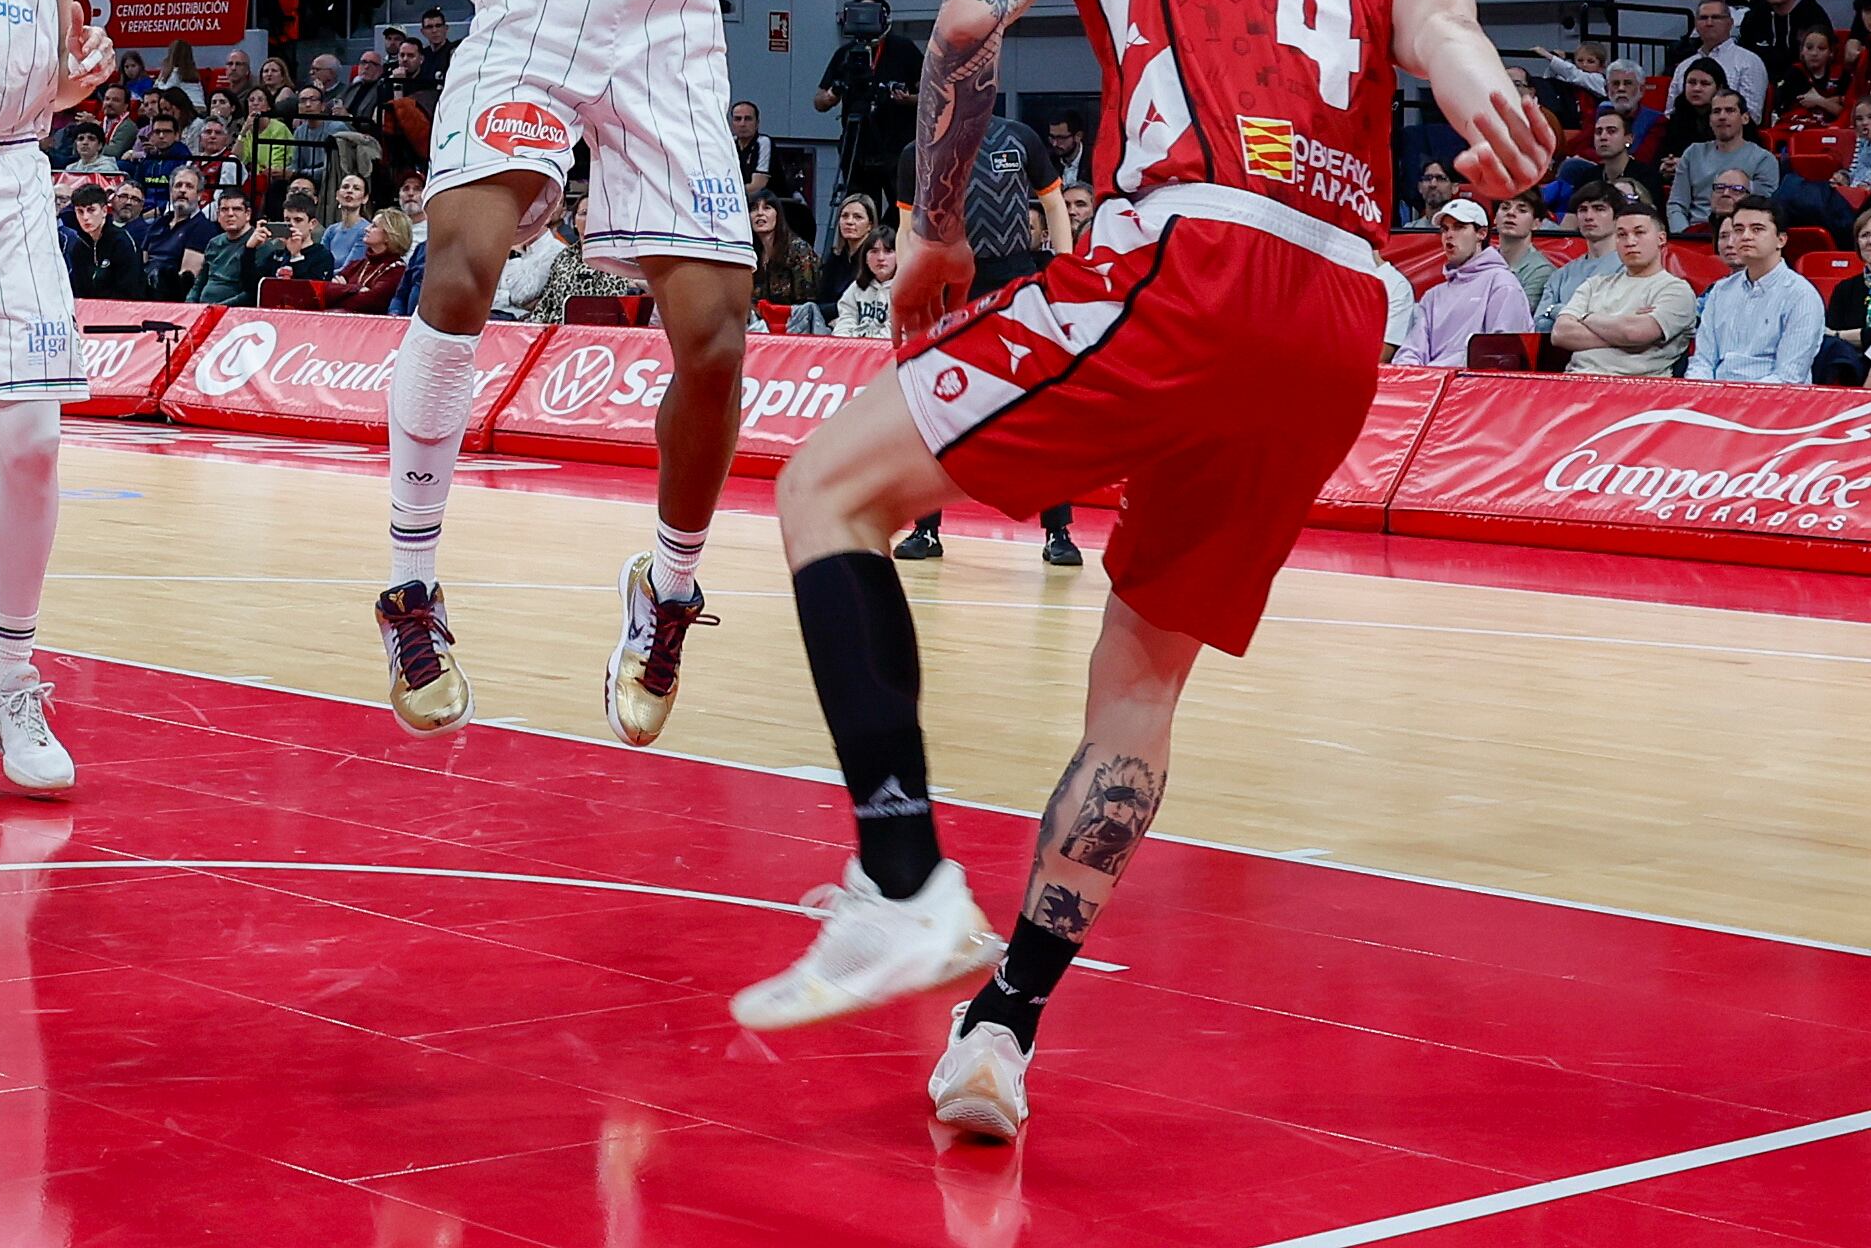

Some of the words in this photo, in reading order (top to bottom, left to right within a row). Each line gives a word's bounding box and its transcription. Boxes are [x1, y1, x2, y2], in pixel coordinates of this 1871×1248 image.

[116, 3, 152, 18] CENTRO
[153, 2, 166, 16] DE
[120, 20, 127, 33] Y
[128, 18, 205, 33] REPRESENTACIÓN
[480, 106, 566, 144] famadesa
[1544, 449, 1871, 511] Campodulce
